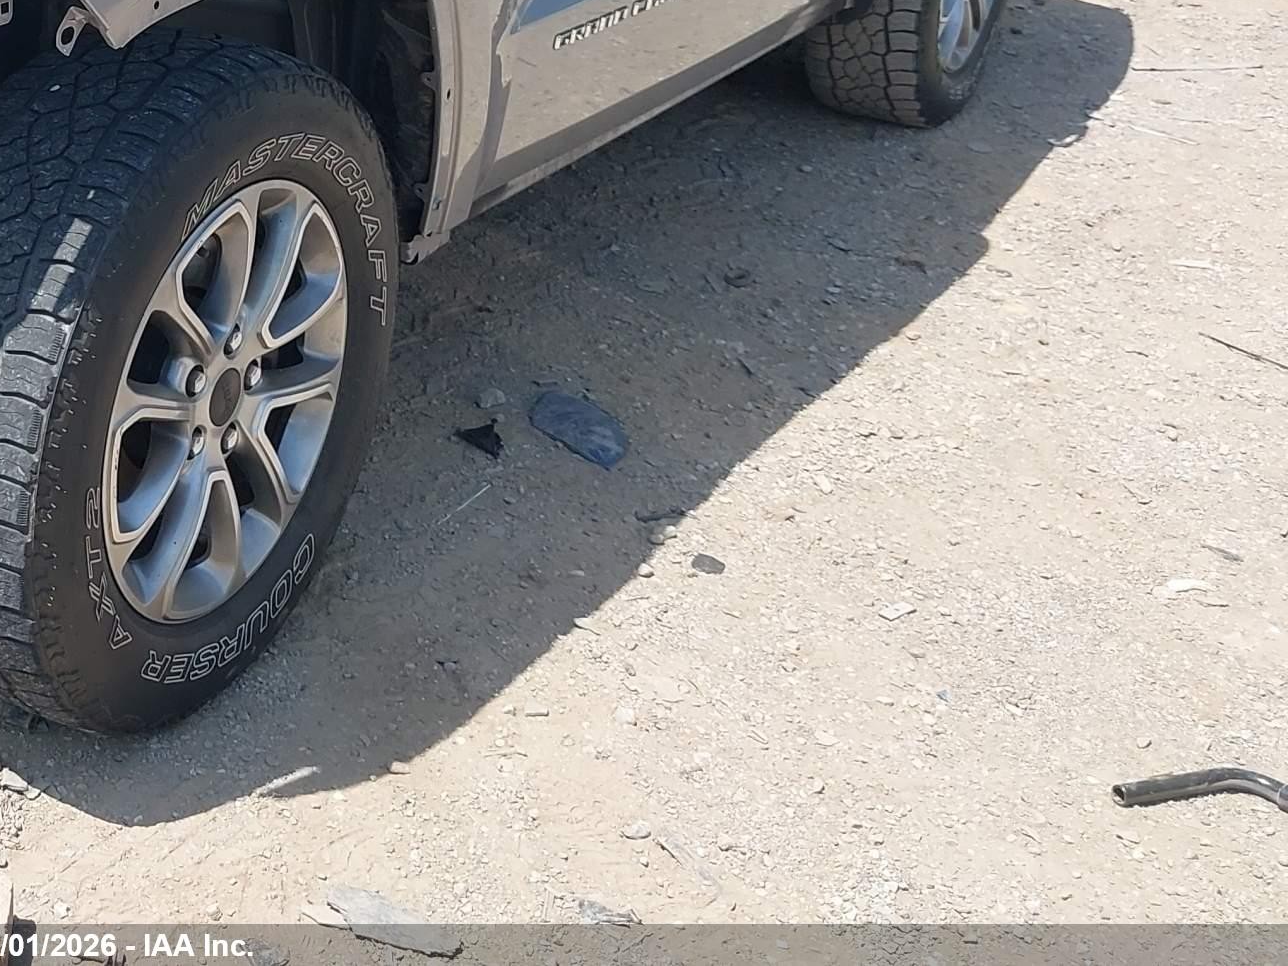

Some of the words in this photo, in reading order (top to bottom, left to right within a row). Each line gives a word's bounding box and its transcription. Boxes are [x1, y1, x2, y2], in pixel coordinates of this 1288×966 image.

[552, 4, 629, 50] GRAND
[181, 132, 388, 326] MASTERCRAFT
[140, 533, 315, 684] COURSER
